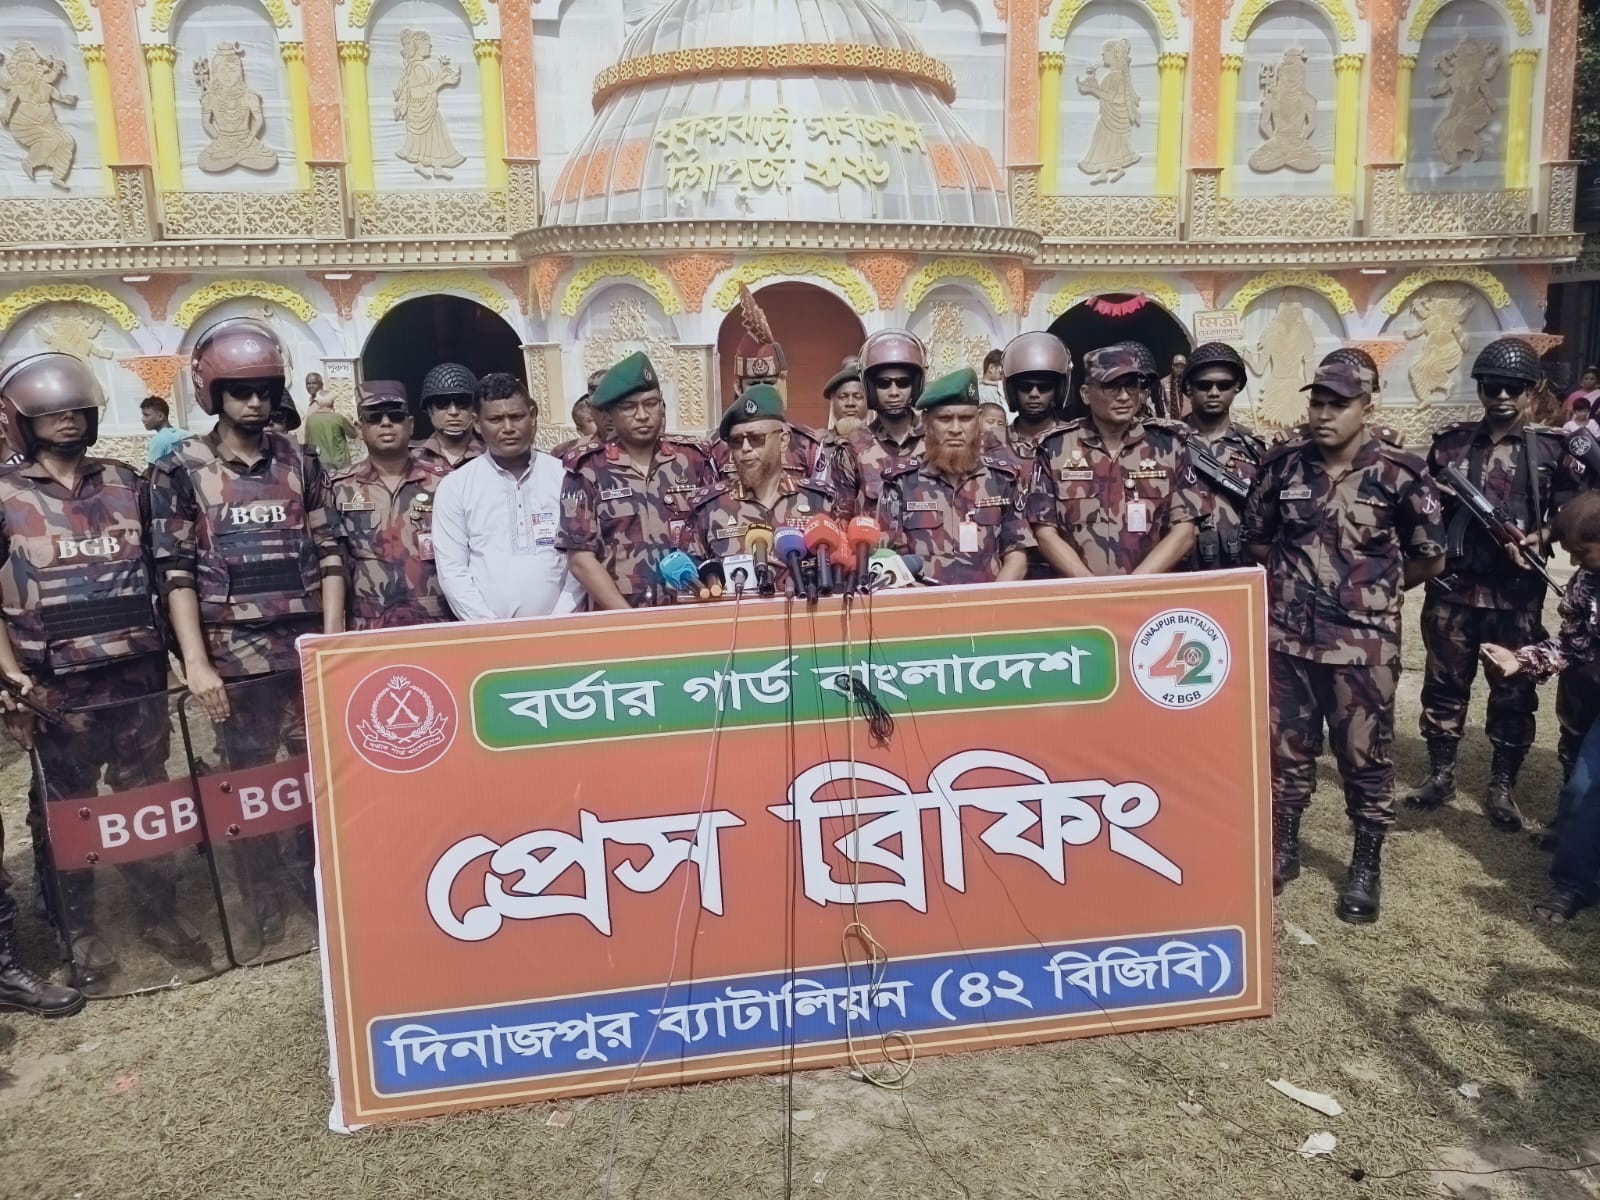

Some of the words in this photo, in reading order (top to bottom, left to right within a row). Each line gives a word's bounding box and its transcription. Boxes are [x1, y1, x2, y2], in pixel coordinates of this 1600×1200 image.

[230, 505, 287, 525] BGB
[56, 536, 121, 559] BGB
[1140, 615, 1176, 647] DINAJPUR
[1178, 615, 1219, 642] BATTALION
[1148, 631, 1213, 687] 42
[500, 670, 664, 728] বর্ডার
[683, 654, 799, 711] গার্ড
[810, 645, 1091, 702] বাংলাদেশ
[1162, 692, 1175, 703] 42
[1177, 690, 1202, 704] BGB
[239, 773, 313, 822] BG
[98, 797, 199, 849] BGB
[427, 810, 746, 942] প্রেস
[767, 749, 1183, 914] ব্রিফিং
[383, 1012, 639, 1077] দিনাজপুর
[649, 978, 912, 1044] ব্যাটালিয়ন
[931, 969, 1033, 1021] (৪২
[1043, 940, 1232, 999] বিজিবি)
